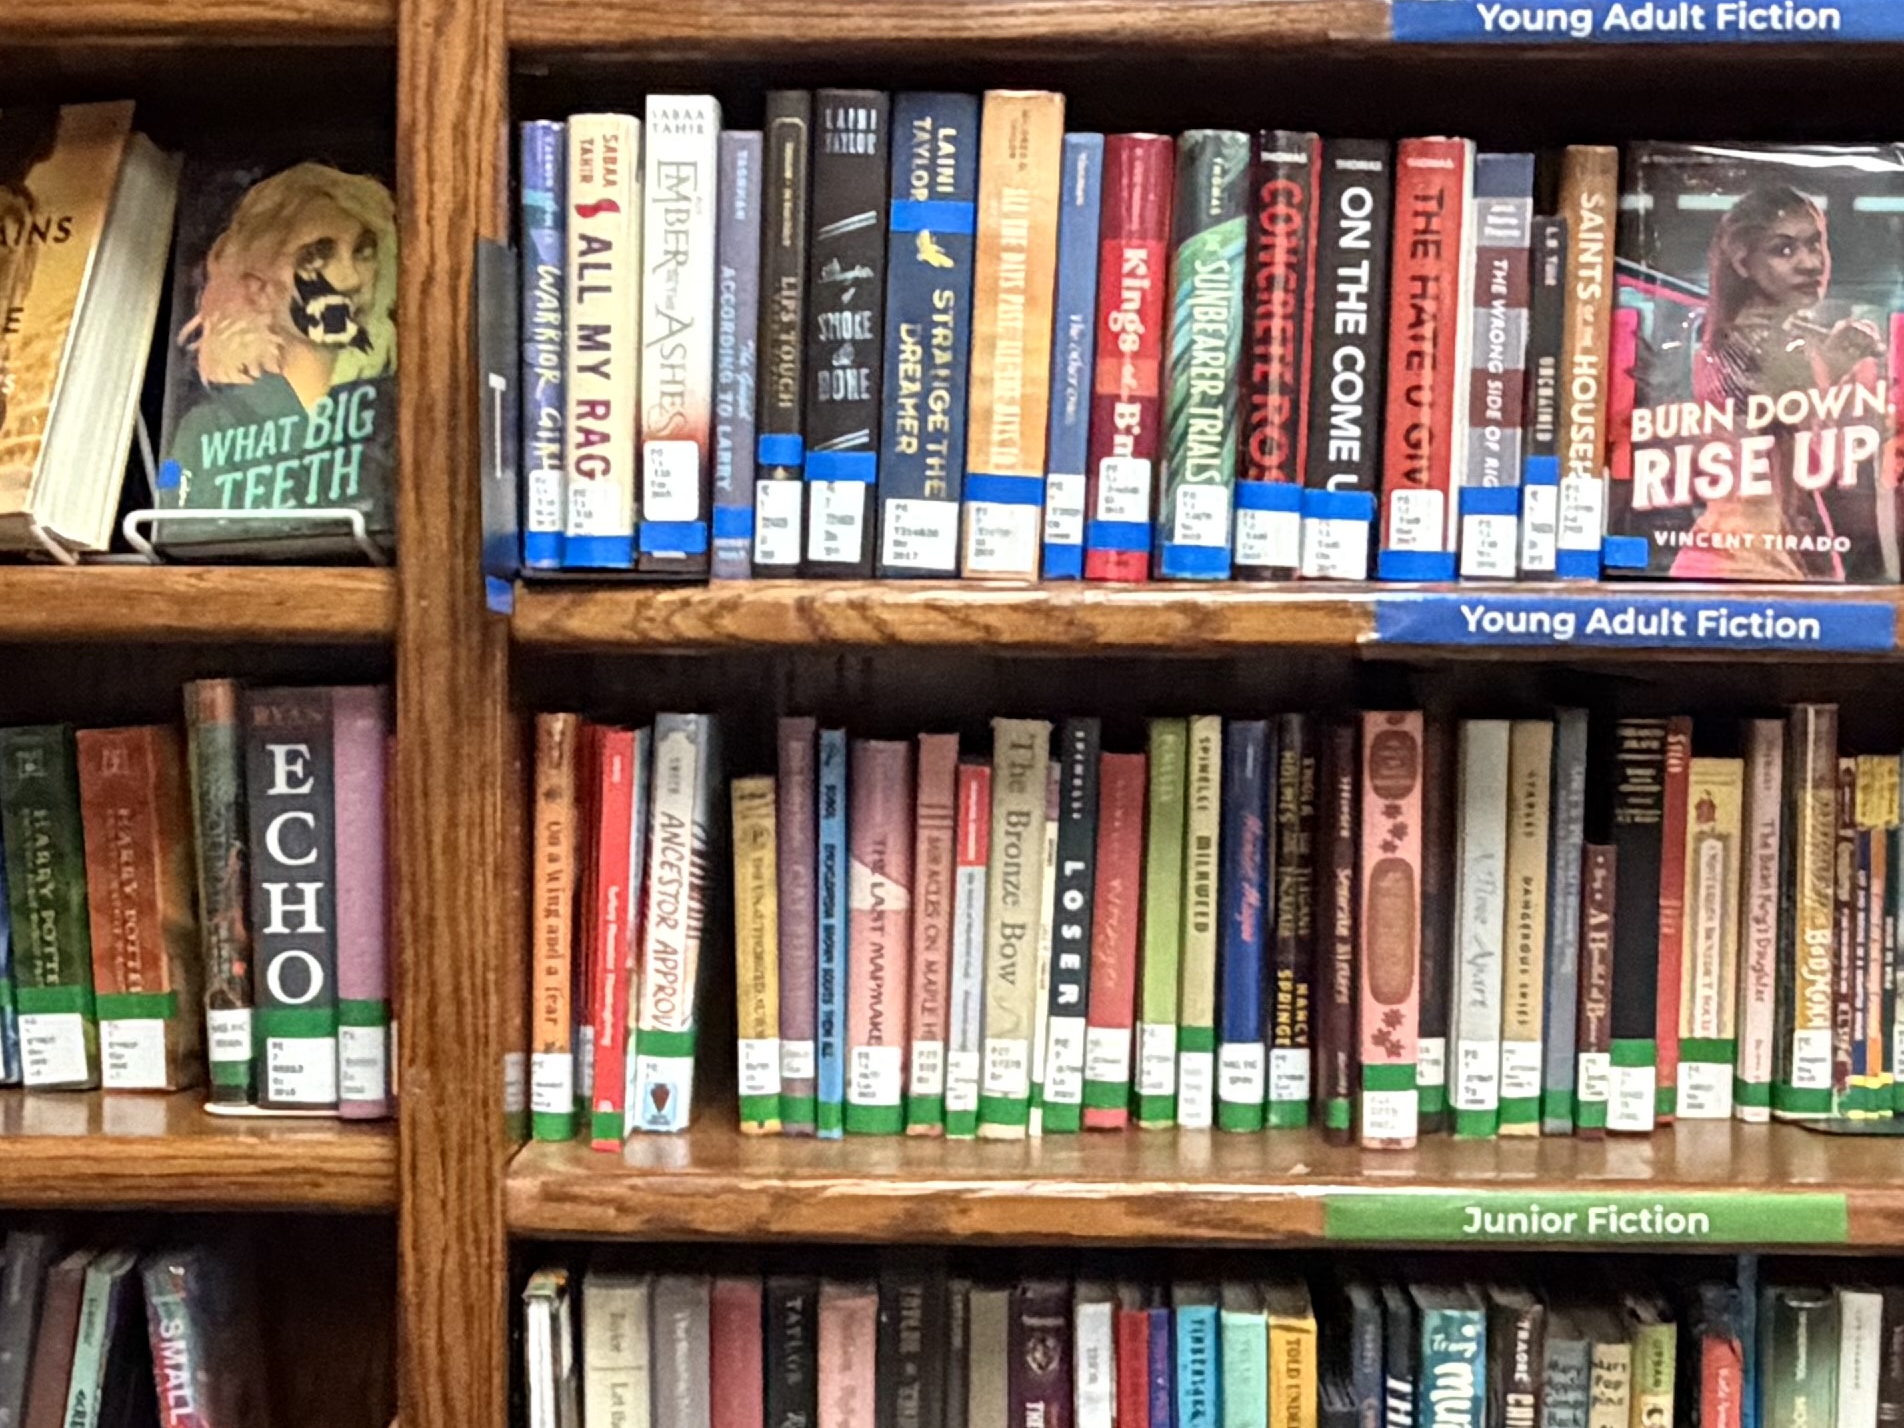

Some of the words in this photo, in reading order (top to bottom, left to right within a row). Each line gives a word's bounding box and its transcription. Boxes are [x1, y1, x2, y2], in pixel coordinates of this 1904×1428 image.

[1477, 3, 1594, 38] Young
[1602, 3, 1705, 32] Adult
[1716, 3, 1840, 32] Fiction
[578, 137, 595, 185] TAHIR
[602, 133, 619, 188] SABAA
[936, 127, 957, 192] LAINI
[1336, 185, 1374, 243] ON
[1335, 257, 1372, 319] THE
[895, 324, 922, 455] DREAMER
[924, 289, 955, 433] STRANGE
[201, 418, 297, 471] WHAT
[305, 385, 375, 446] BIG
[1327, 329, 1370, 465] COME
[1631, 399, 1737, 443] BURN
[215, 448, 362, 510] TEETH
[923, 442, 948, 498] THE
[1631, 434, 1778, 512] RISE
[1790, 426, 1882, 493] UP
[1654, 529, 1756, 551] VINCENT
[1762, 531, 1852, 554] TIRADO
[1461, 607, 1584, 644] Young
[1594, 608, 1685, 638] Adult
[1697, 608, 1820, 640] Fiction
[1008, 735, 1036, 793] The
[262, 744, 326, 1004] ECHO
[1001, 810, 1027, 907] Bronze
[998, 921, 1027, 986] Bow
[1057, 861, 1085, 1005] LOSER
[1462, 1204, 1578, 1235] Junior
[1590, 1206, 1708, 1234] Fiction
[159, 1316, 197, 1427] SMALL
